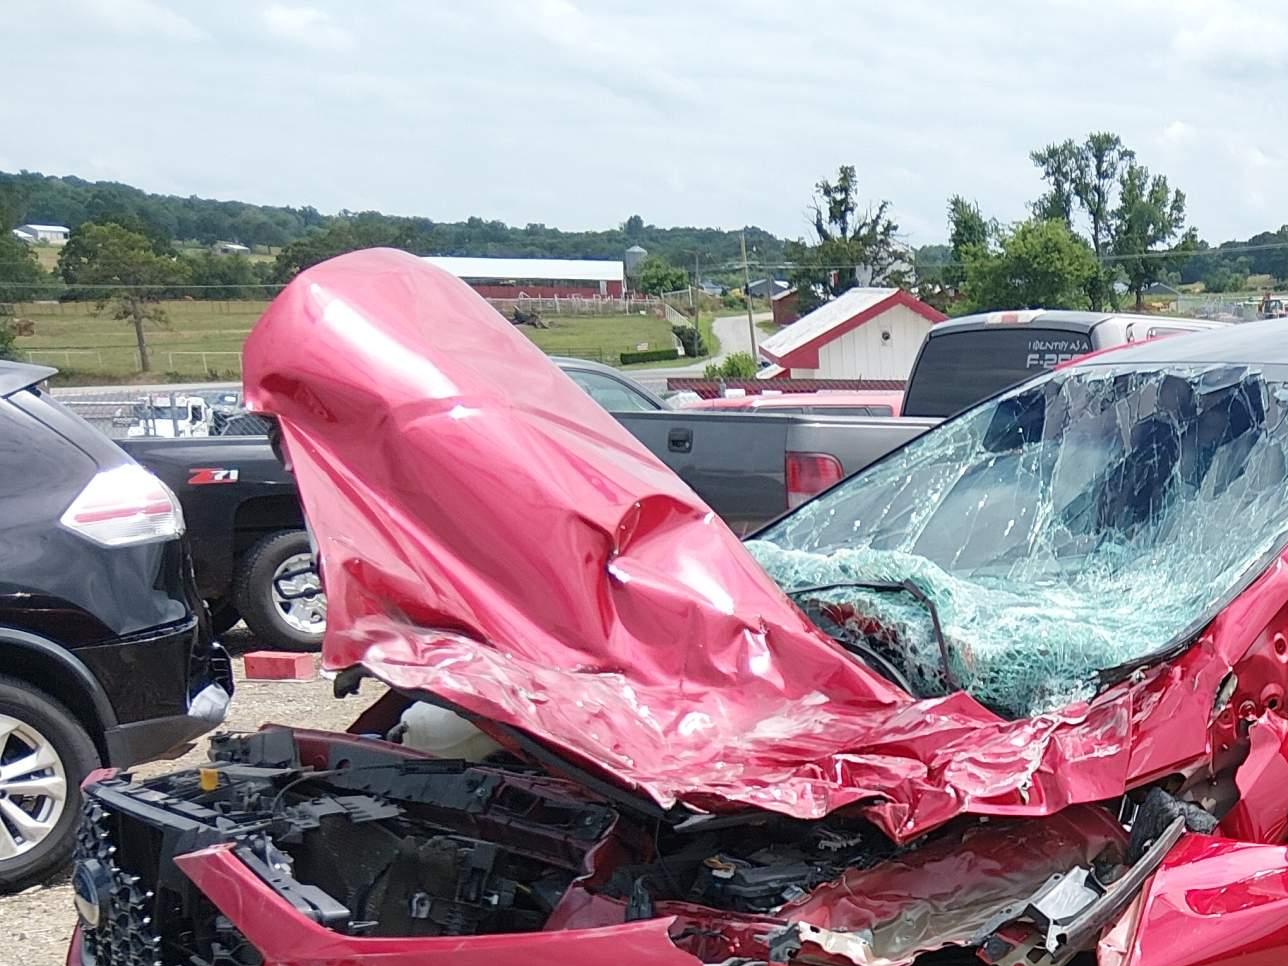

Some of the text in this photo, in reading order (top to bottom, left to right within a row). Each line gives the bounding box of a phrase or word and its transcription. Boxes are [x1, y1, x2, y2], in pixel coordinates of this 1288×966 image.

[1069, 340, 1081, 352] AS
[1081, 342, 1089, 350] A
[188, 467, 239, 485] Z71
